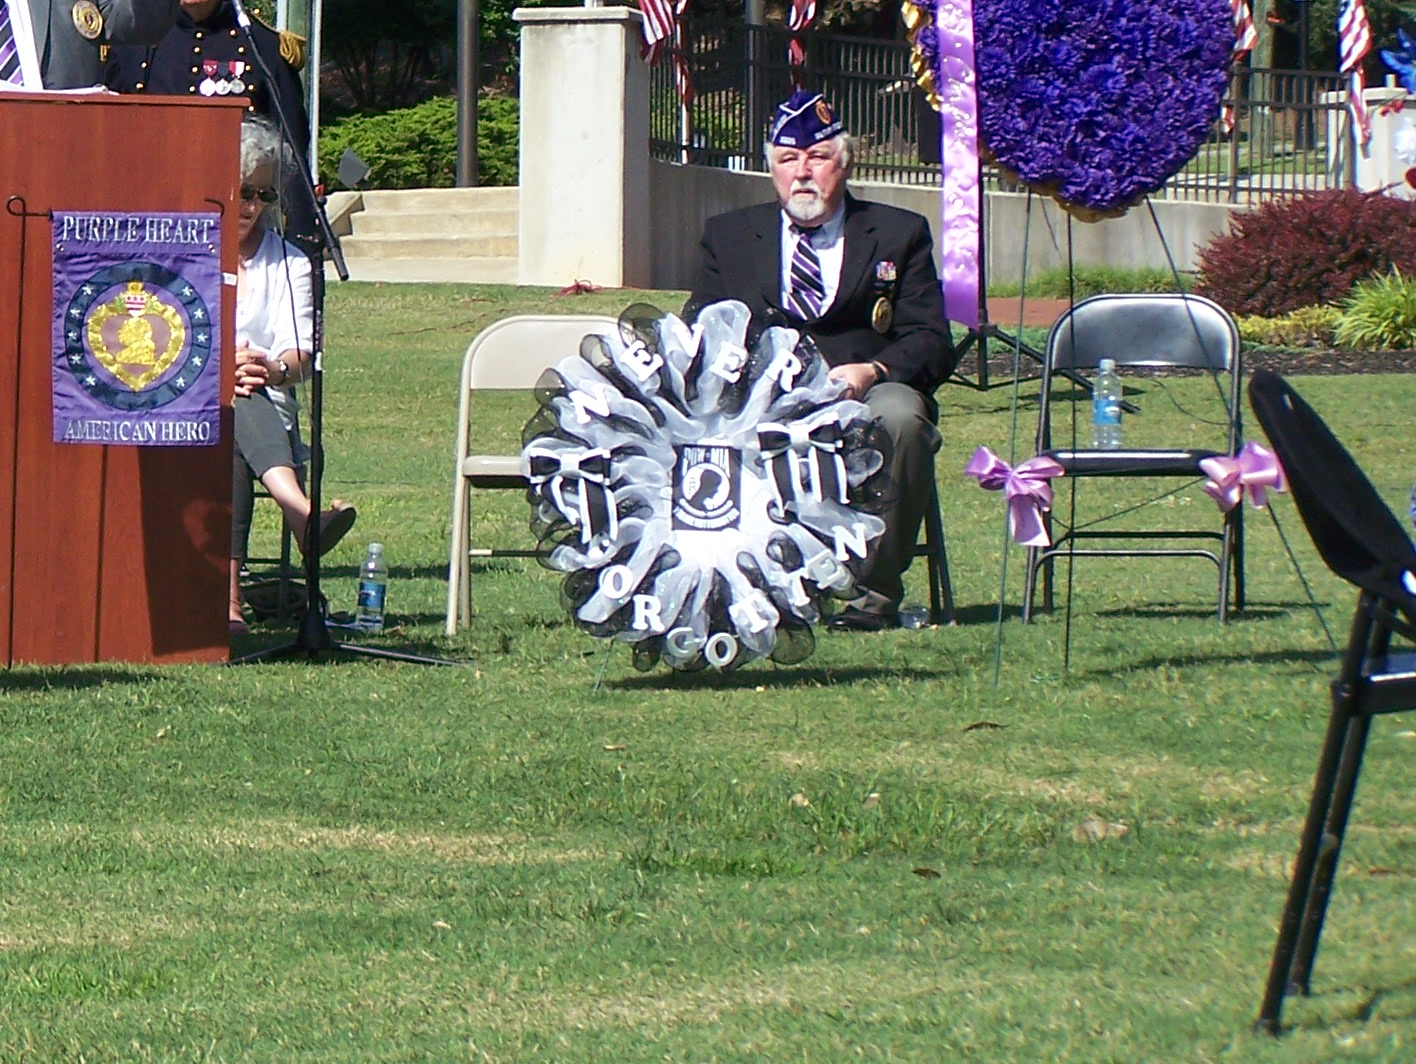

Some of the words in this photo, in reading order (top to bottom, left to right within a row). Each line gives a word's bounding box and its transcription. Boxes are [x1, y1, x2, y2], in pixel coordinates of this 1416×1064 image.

[62, 216, 139, 243] PURPLE
[145, 217, 214, 244] HEART
[568, 323, 802, 425] NEVER
[64, 420, 157, 442] AMERICAN
[162, 421, 211, 442] HERO
[587, 524, 869, 667] ORGOTTEN
